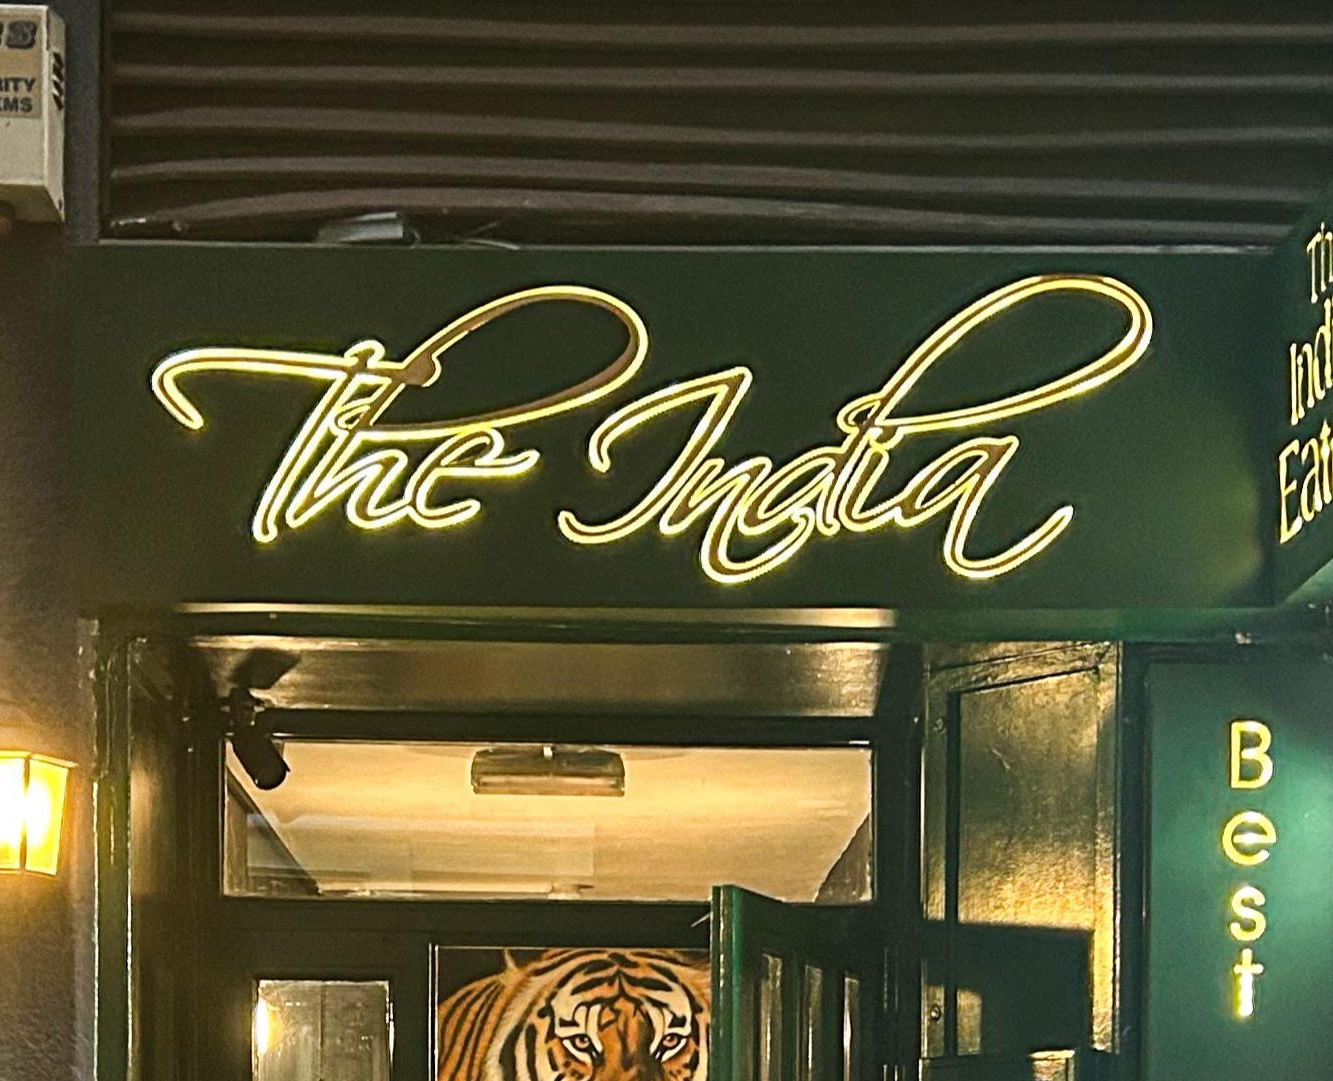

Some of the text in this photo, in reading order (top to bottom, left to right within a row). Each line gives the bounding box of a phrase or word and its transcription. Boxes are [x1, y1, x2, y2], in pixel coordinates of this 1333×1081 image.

[152, 273, 1154, 584] The India
[1222, 720, 1277, 1017] Best
